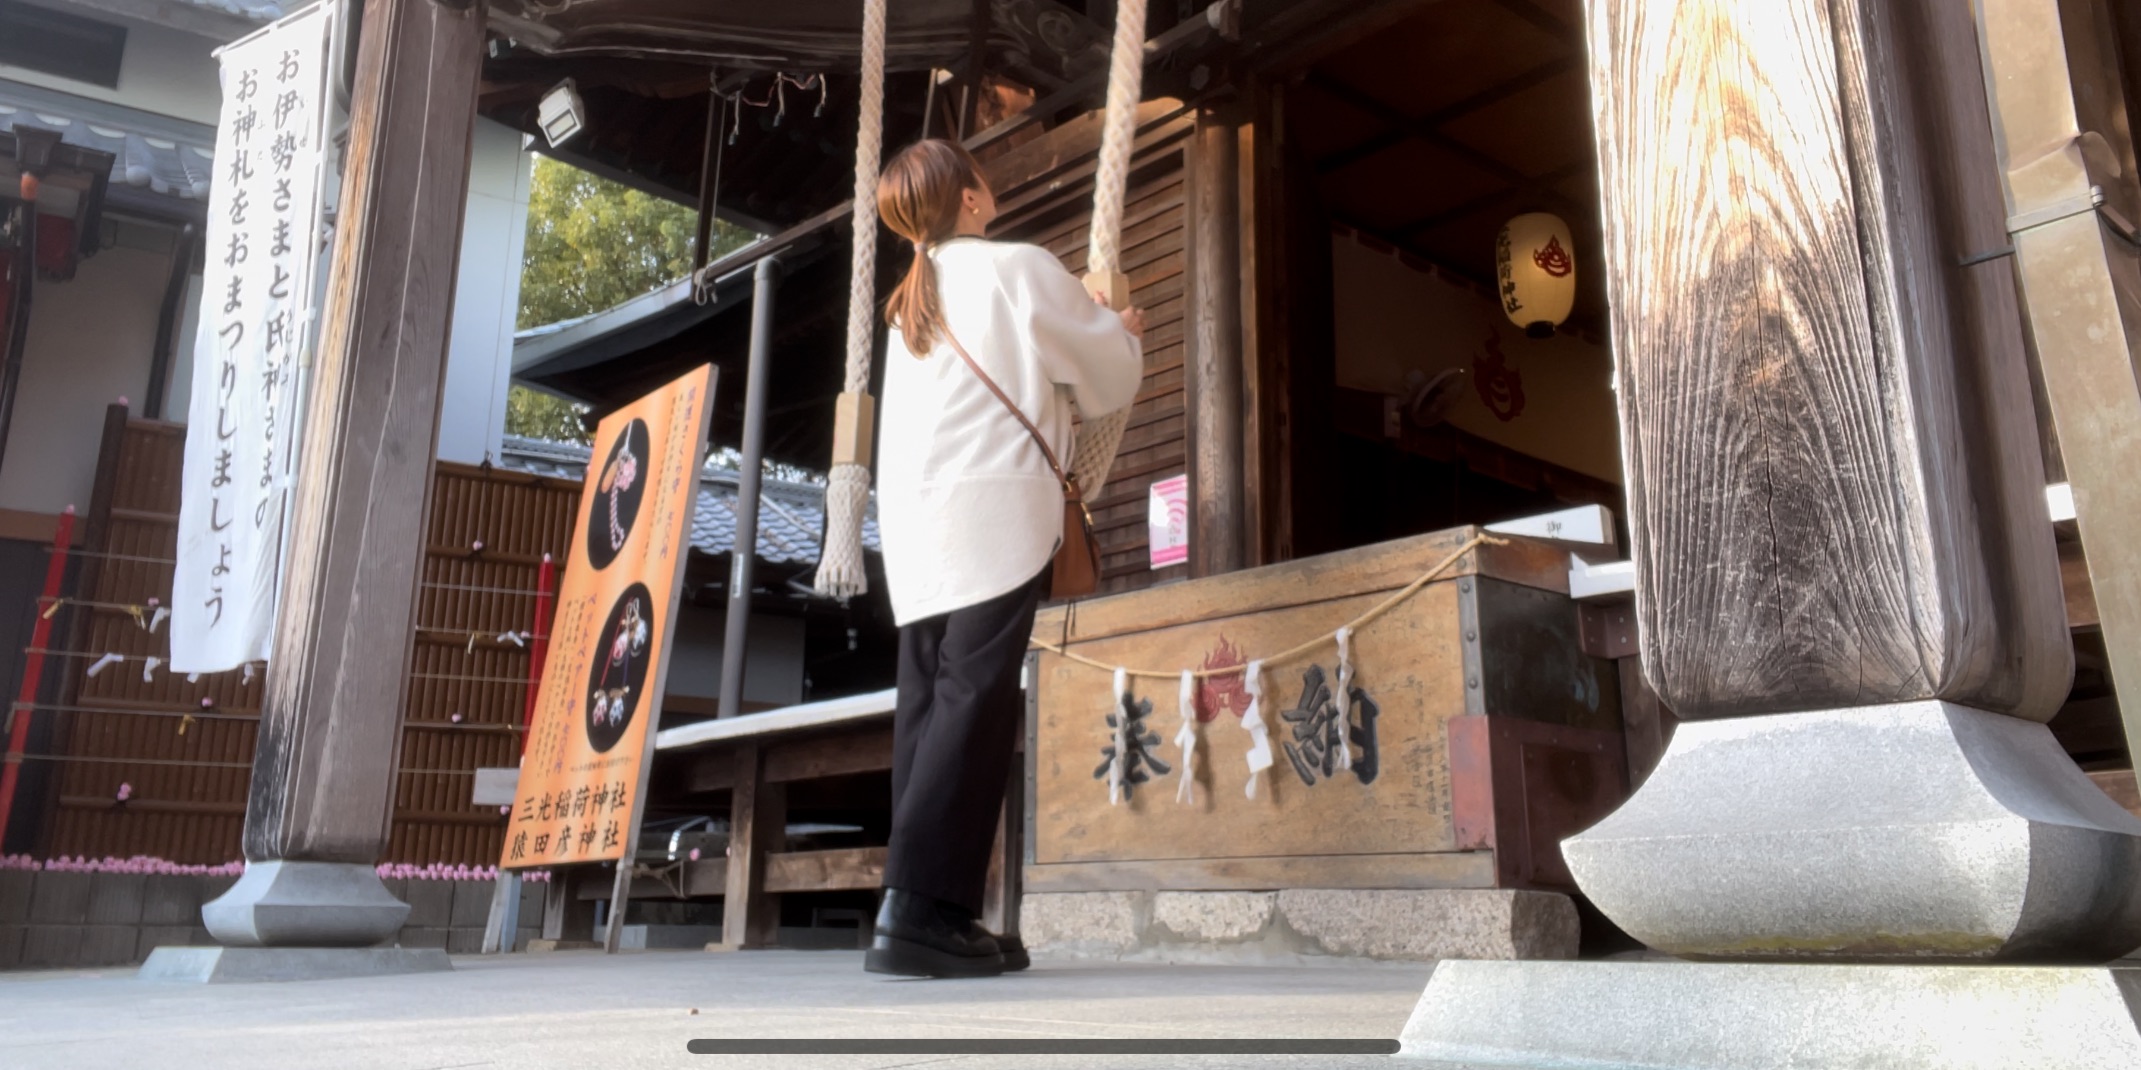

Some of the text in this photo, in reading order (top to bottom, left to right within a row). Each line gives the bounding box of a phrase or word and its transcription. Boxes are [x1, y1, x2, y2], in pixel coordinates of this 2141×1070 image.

[204, 69, 258, 628] お神札をおまつりしましょう
[517, 781, 627, 823] 三光稲荷神社
[510, 820, 620, 861] 猿田彦神社
